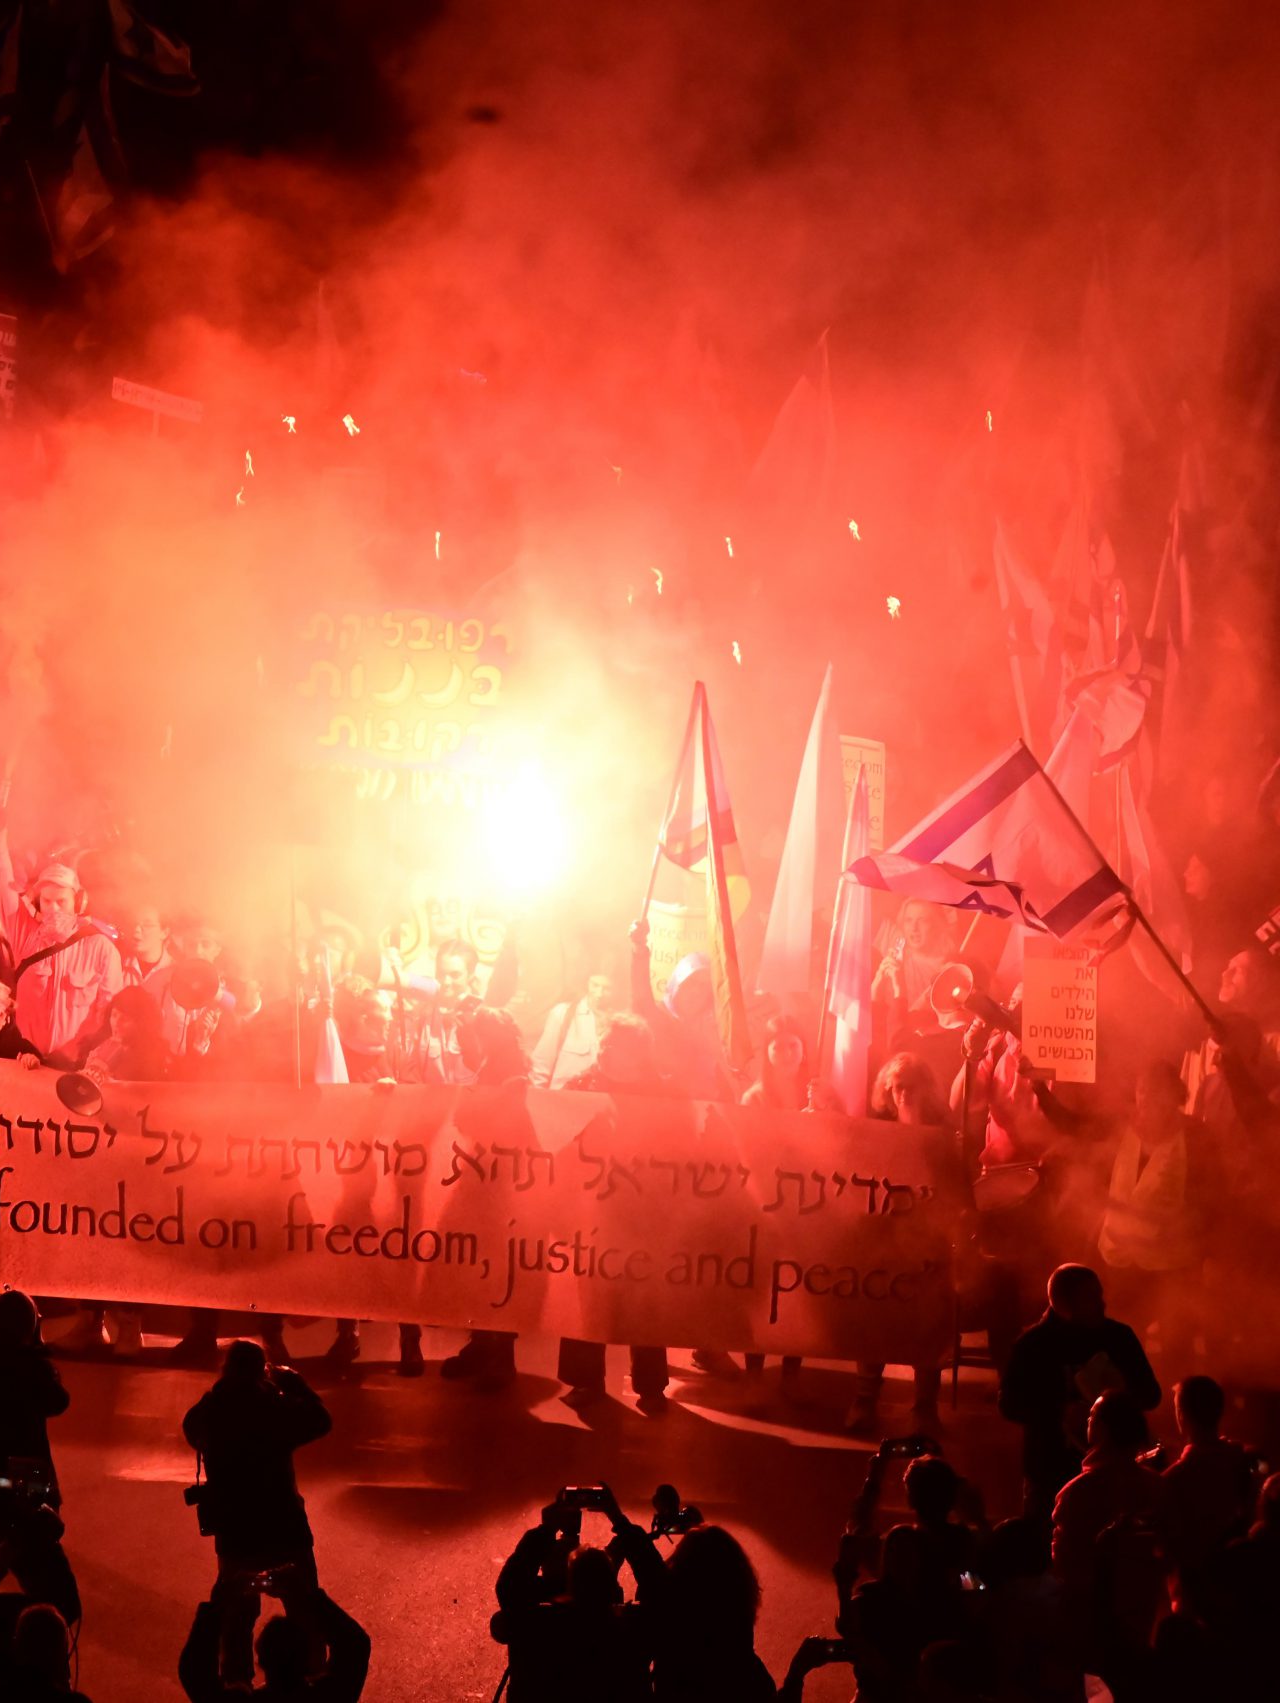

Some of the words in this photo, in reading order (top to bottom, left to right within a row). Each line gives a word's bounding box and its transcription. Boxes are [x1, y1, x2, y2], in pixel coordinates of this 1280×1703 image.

[1075, 967, 1094, 980] את
[1051, 984, 1095, 1001] הילדים
[1065, 1005, 1095, 1021] שלנו
[1029, 1025, 1094, 1041] מהשטחים
[1038, 1045, 1094, 1061] הכבושים
[136, 1104, 202, 1175] על
[214, 1134, 428, 1180] מושתתת
[441, 1140, 555, 1192] תהא
[574, 1132, 751, 1200] ישראל
[198, 1217, 257, 1251] on
[282, 1192, 491, 1280] freedom,
[491, 1217, 652, 1309] justice
[664, 1223, 758, 1290] and
